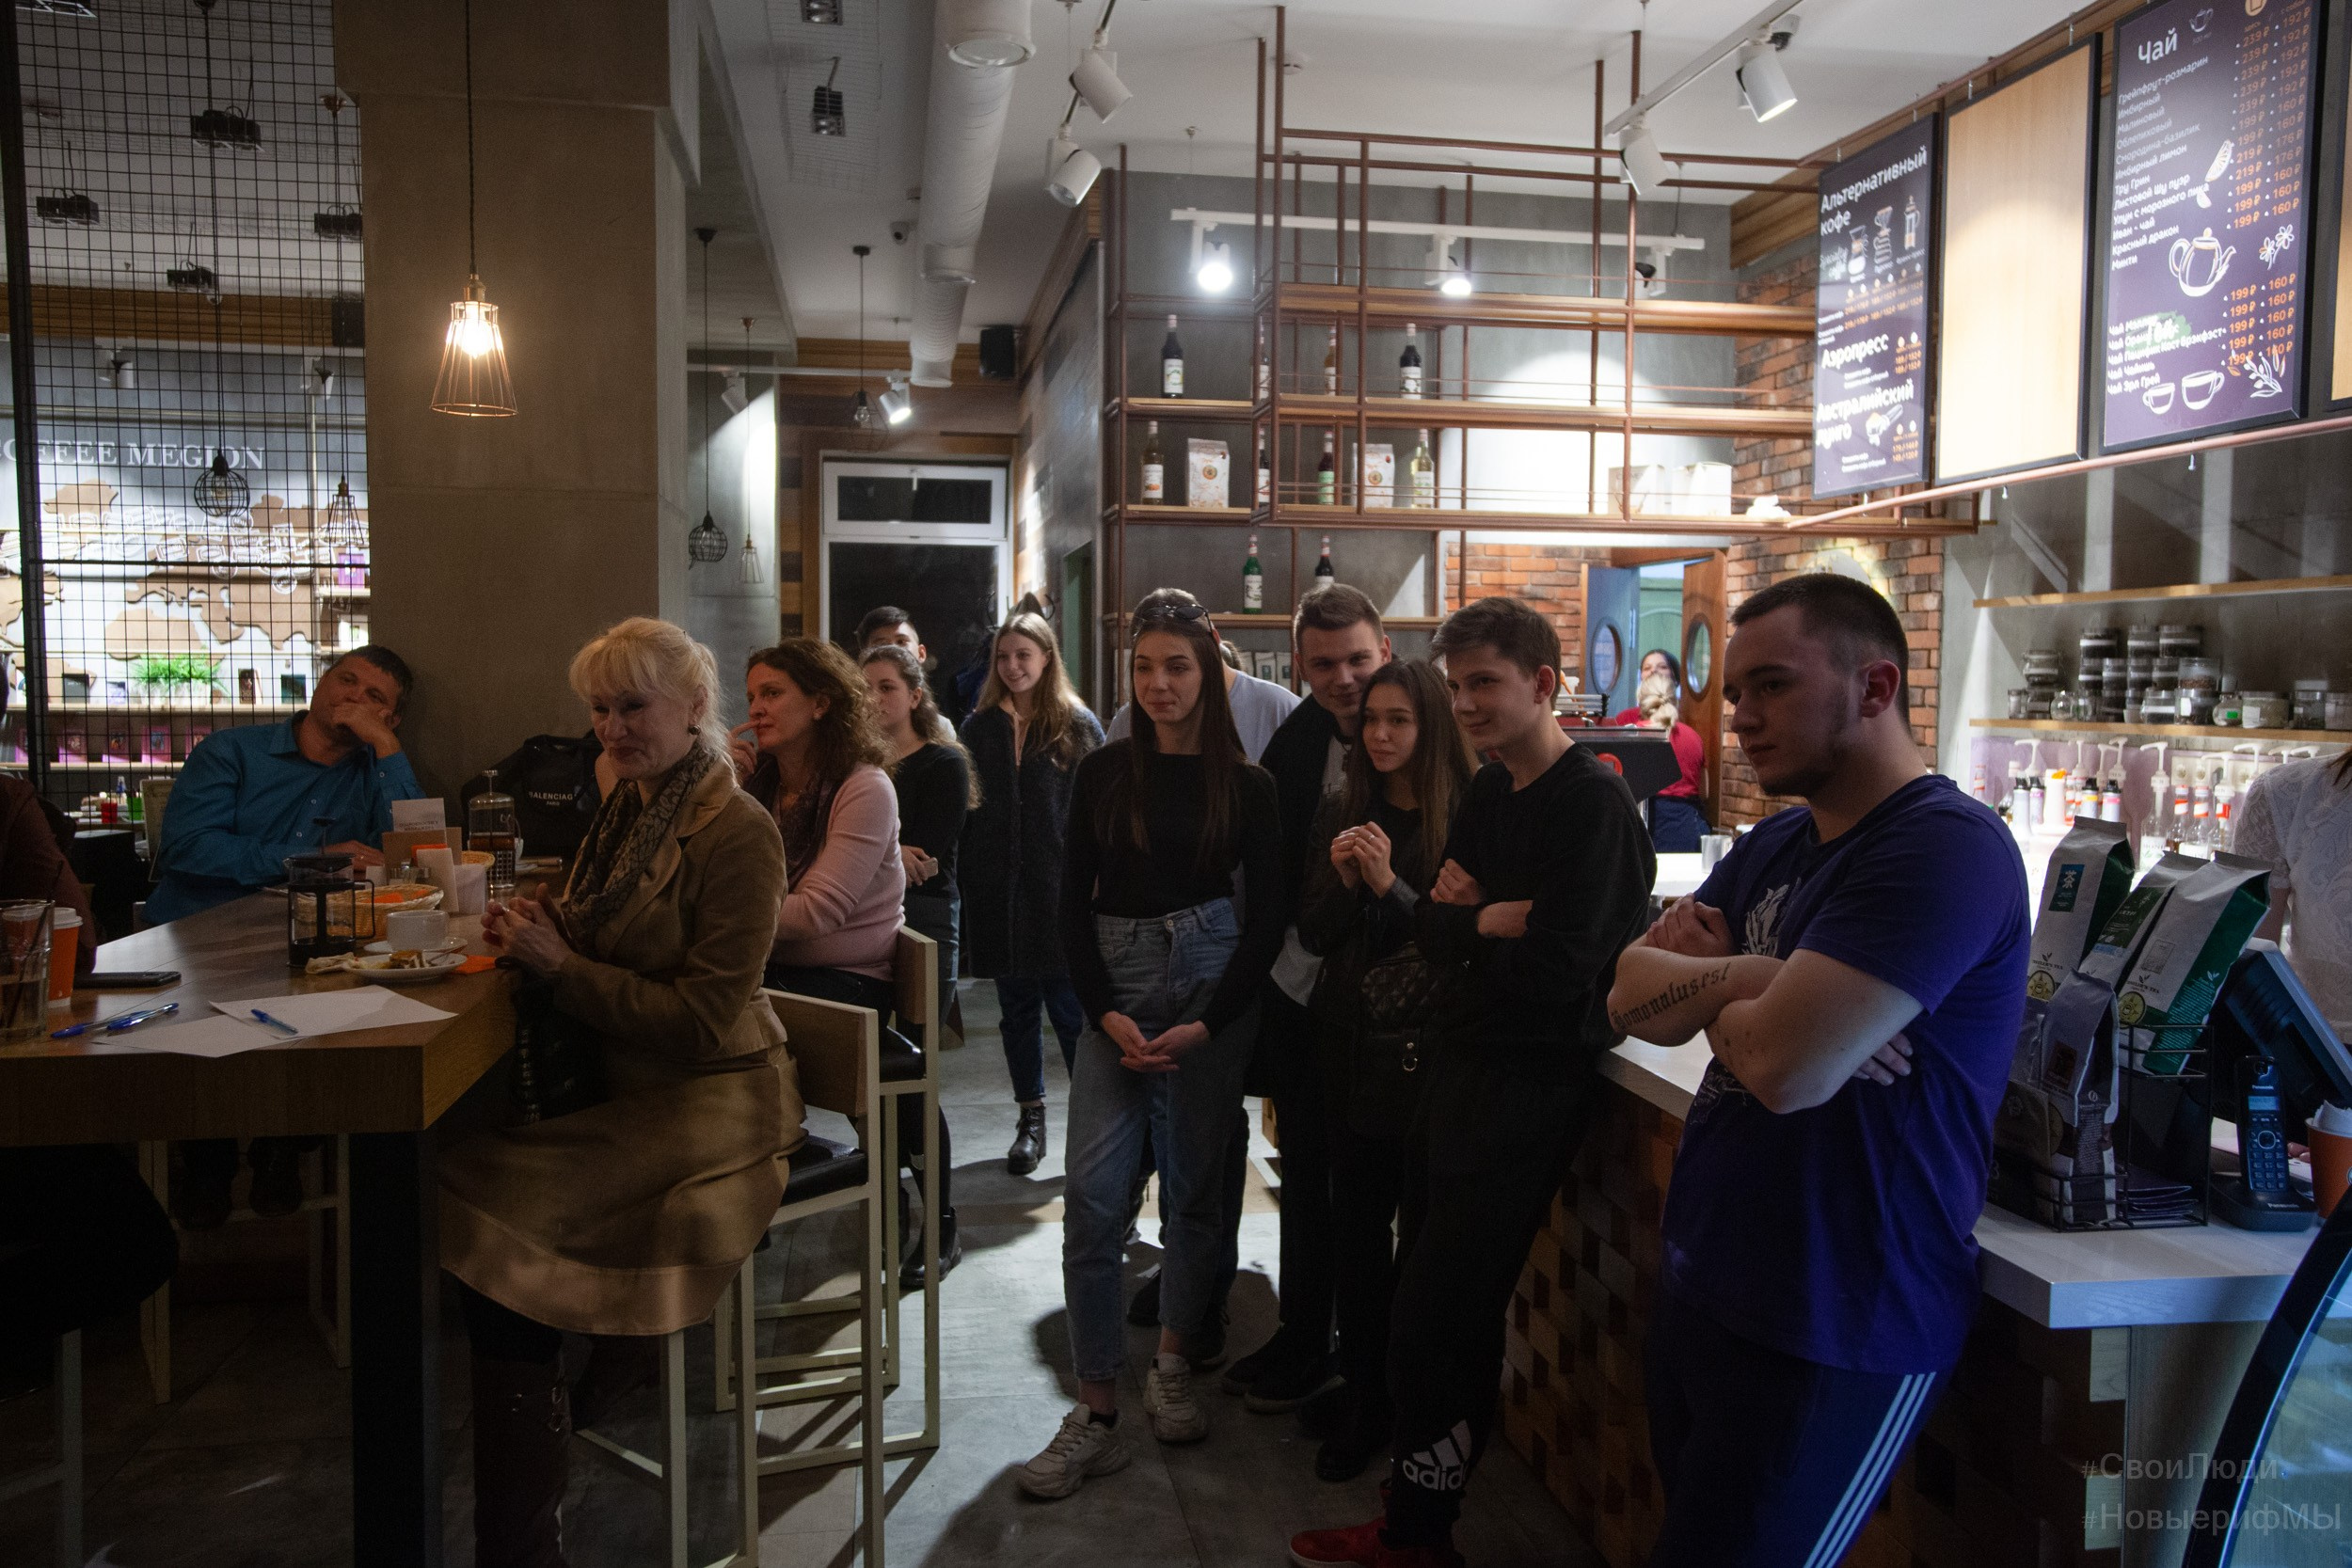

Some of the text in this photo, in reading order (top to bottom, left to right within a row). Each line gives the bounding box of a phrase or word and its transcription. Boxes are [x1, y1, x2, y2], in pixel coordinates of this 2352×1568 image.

[2283, 11, 2301, 28] 192
[2243, 30, 2262, 47] 239
[2282, 28, 2300, 45] 192
[2137, 27, 2178, 64] Чай
[2242, 47, 2261, 64] 239
[2281, 46, 2299, 62] 192
[2241, 64, 2260, 80] 239
[2280, 63, 2298, 79] 192
[2240, 81, 2259, 97] 239
[2280, 80, 2297, 96] 192
[2239, 97, 2258, 113] 239
[2279, 98, 2296, 113] 160
[2117, 105, 2165, 135] Малиновый
[2239, 114, 2257, 130] 199
[2278, 115, 2296, 130] 160
[2115, 123, 2201, 165] Смородина-базилик
[2238, 131, 2257, 146] 199
[2277, 132, 2295, 147] 176
[2159, 144, 2187, 163] лимон
[2237, 148, 2256, 163] 219
[2276, 150, 2294, 165] 176
[1820, 145, 1928, 213] Альтернативный
[2236, 165, 2255, 179] 219
[2275, 166, 2293, 182] 160
[2130, 174, 2151, 190] Грин
[2235, 181, 2254, 196] 199
[2113, 187, 2153, 211] Листовой
[2169, 174, 2190, 190] пуэр
[2274, 183, 2292, 198] 160
[2140, 191, 2187, 215] морозного
[2234, 198, 2253, 212] 199
[2273, 201, 2291, 215] 160
[1820, 210, 1851, 236] кофе
[2233, 214, 2252, 229] 199
[2112, 227, 2133, 241] Иван
[2112, 225, 2180, 257] Красный дракон
[2269, 276, 2287, 290] 160
[2231, 287, 2249, 301] 199
[2268, 293, 2287, 307] 160
[2230, 304, 2248, 317] 199
[2267, 309, 2286, 324] 160
[2230, 320, 2248, 333] 199
[2267, 326, 2285, 341] 160
[2229, 337, 2247, 349] 199
[1821, 333, 1889, 370] Аэропресс
[2228, 353, 2246, 366] 199
[1816, 377, 1914, 422] Австралийский
[0, 438, 264, 469] OFFEE MEGION
[1402, 1459, 1469, 1491] adid
